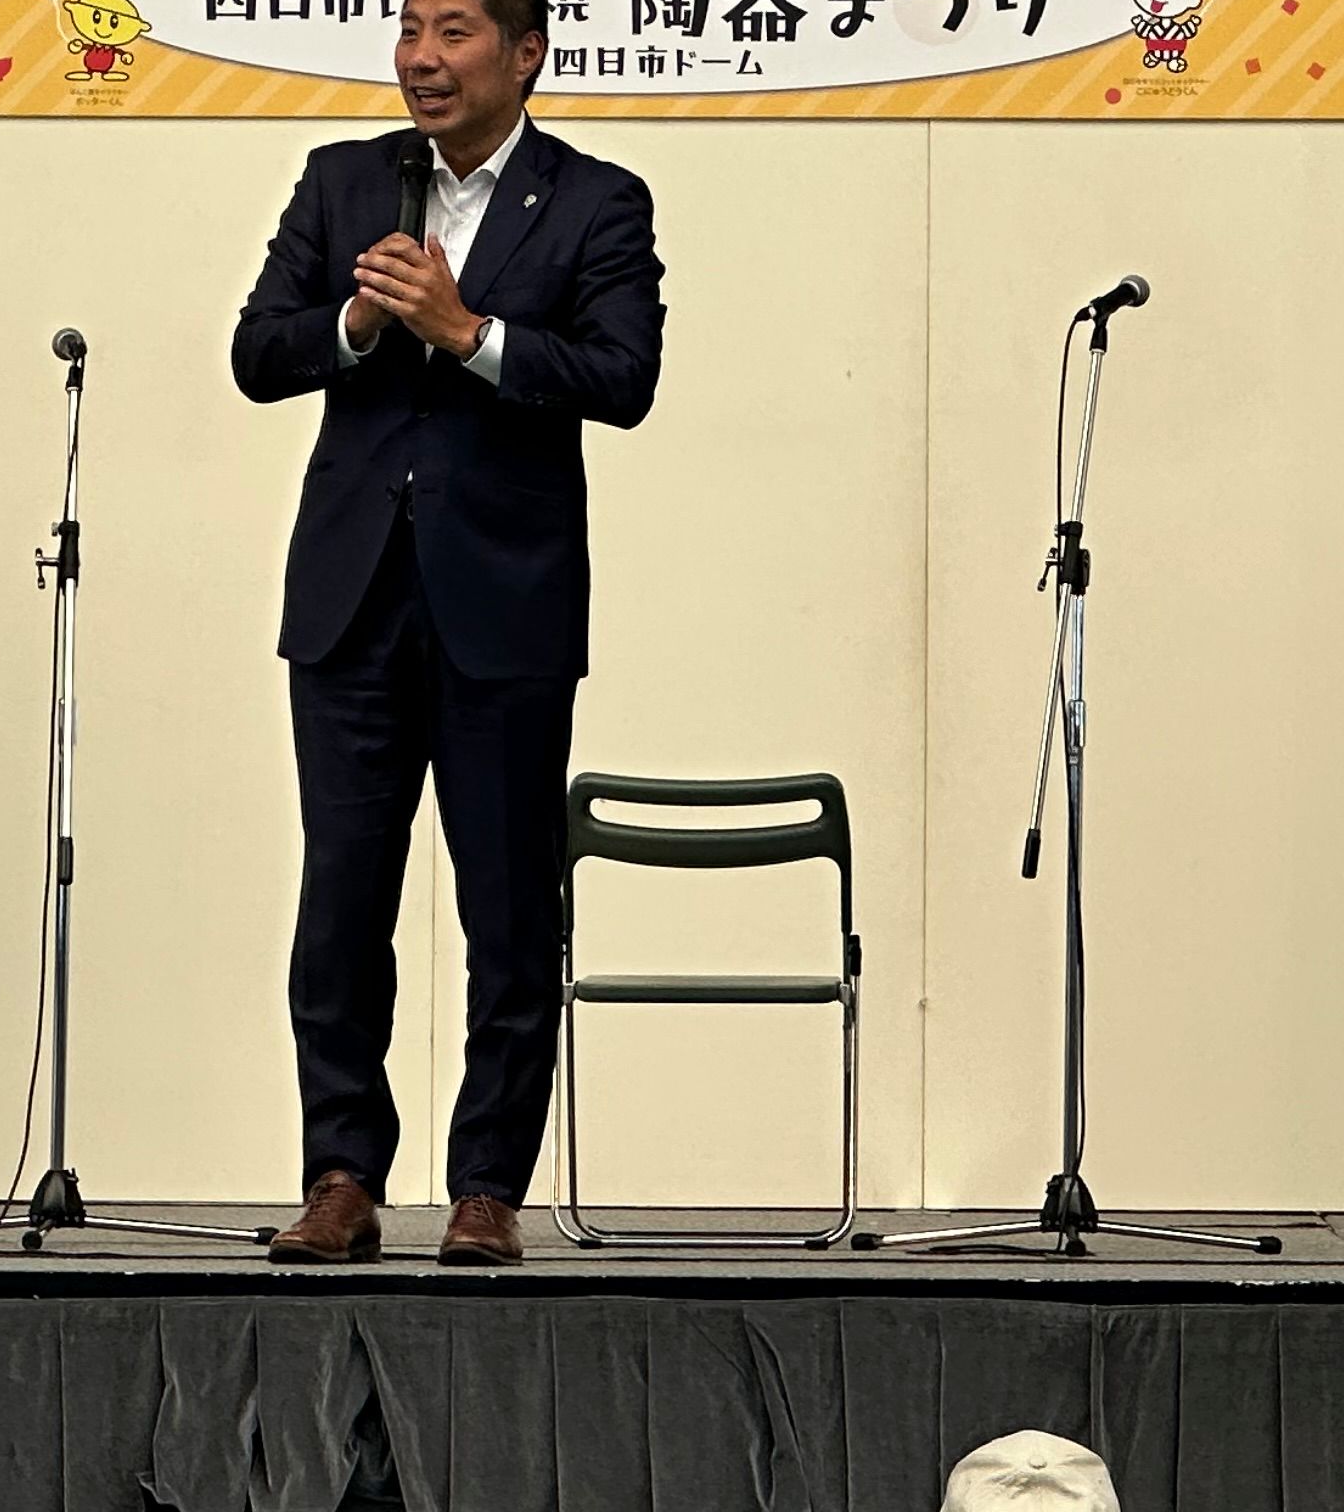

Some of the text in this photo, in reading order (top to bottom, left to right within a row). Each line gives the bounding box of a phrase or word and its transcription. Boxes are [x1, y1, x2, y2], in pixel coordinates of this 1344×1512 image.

[553, 45, 764, 78] 四日市ドーム
